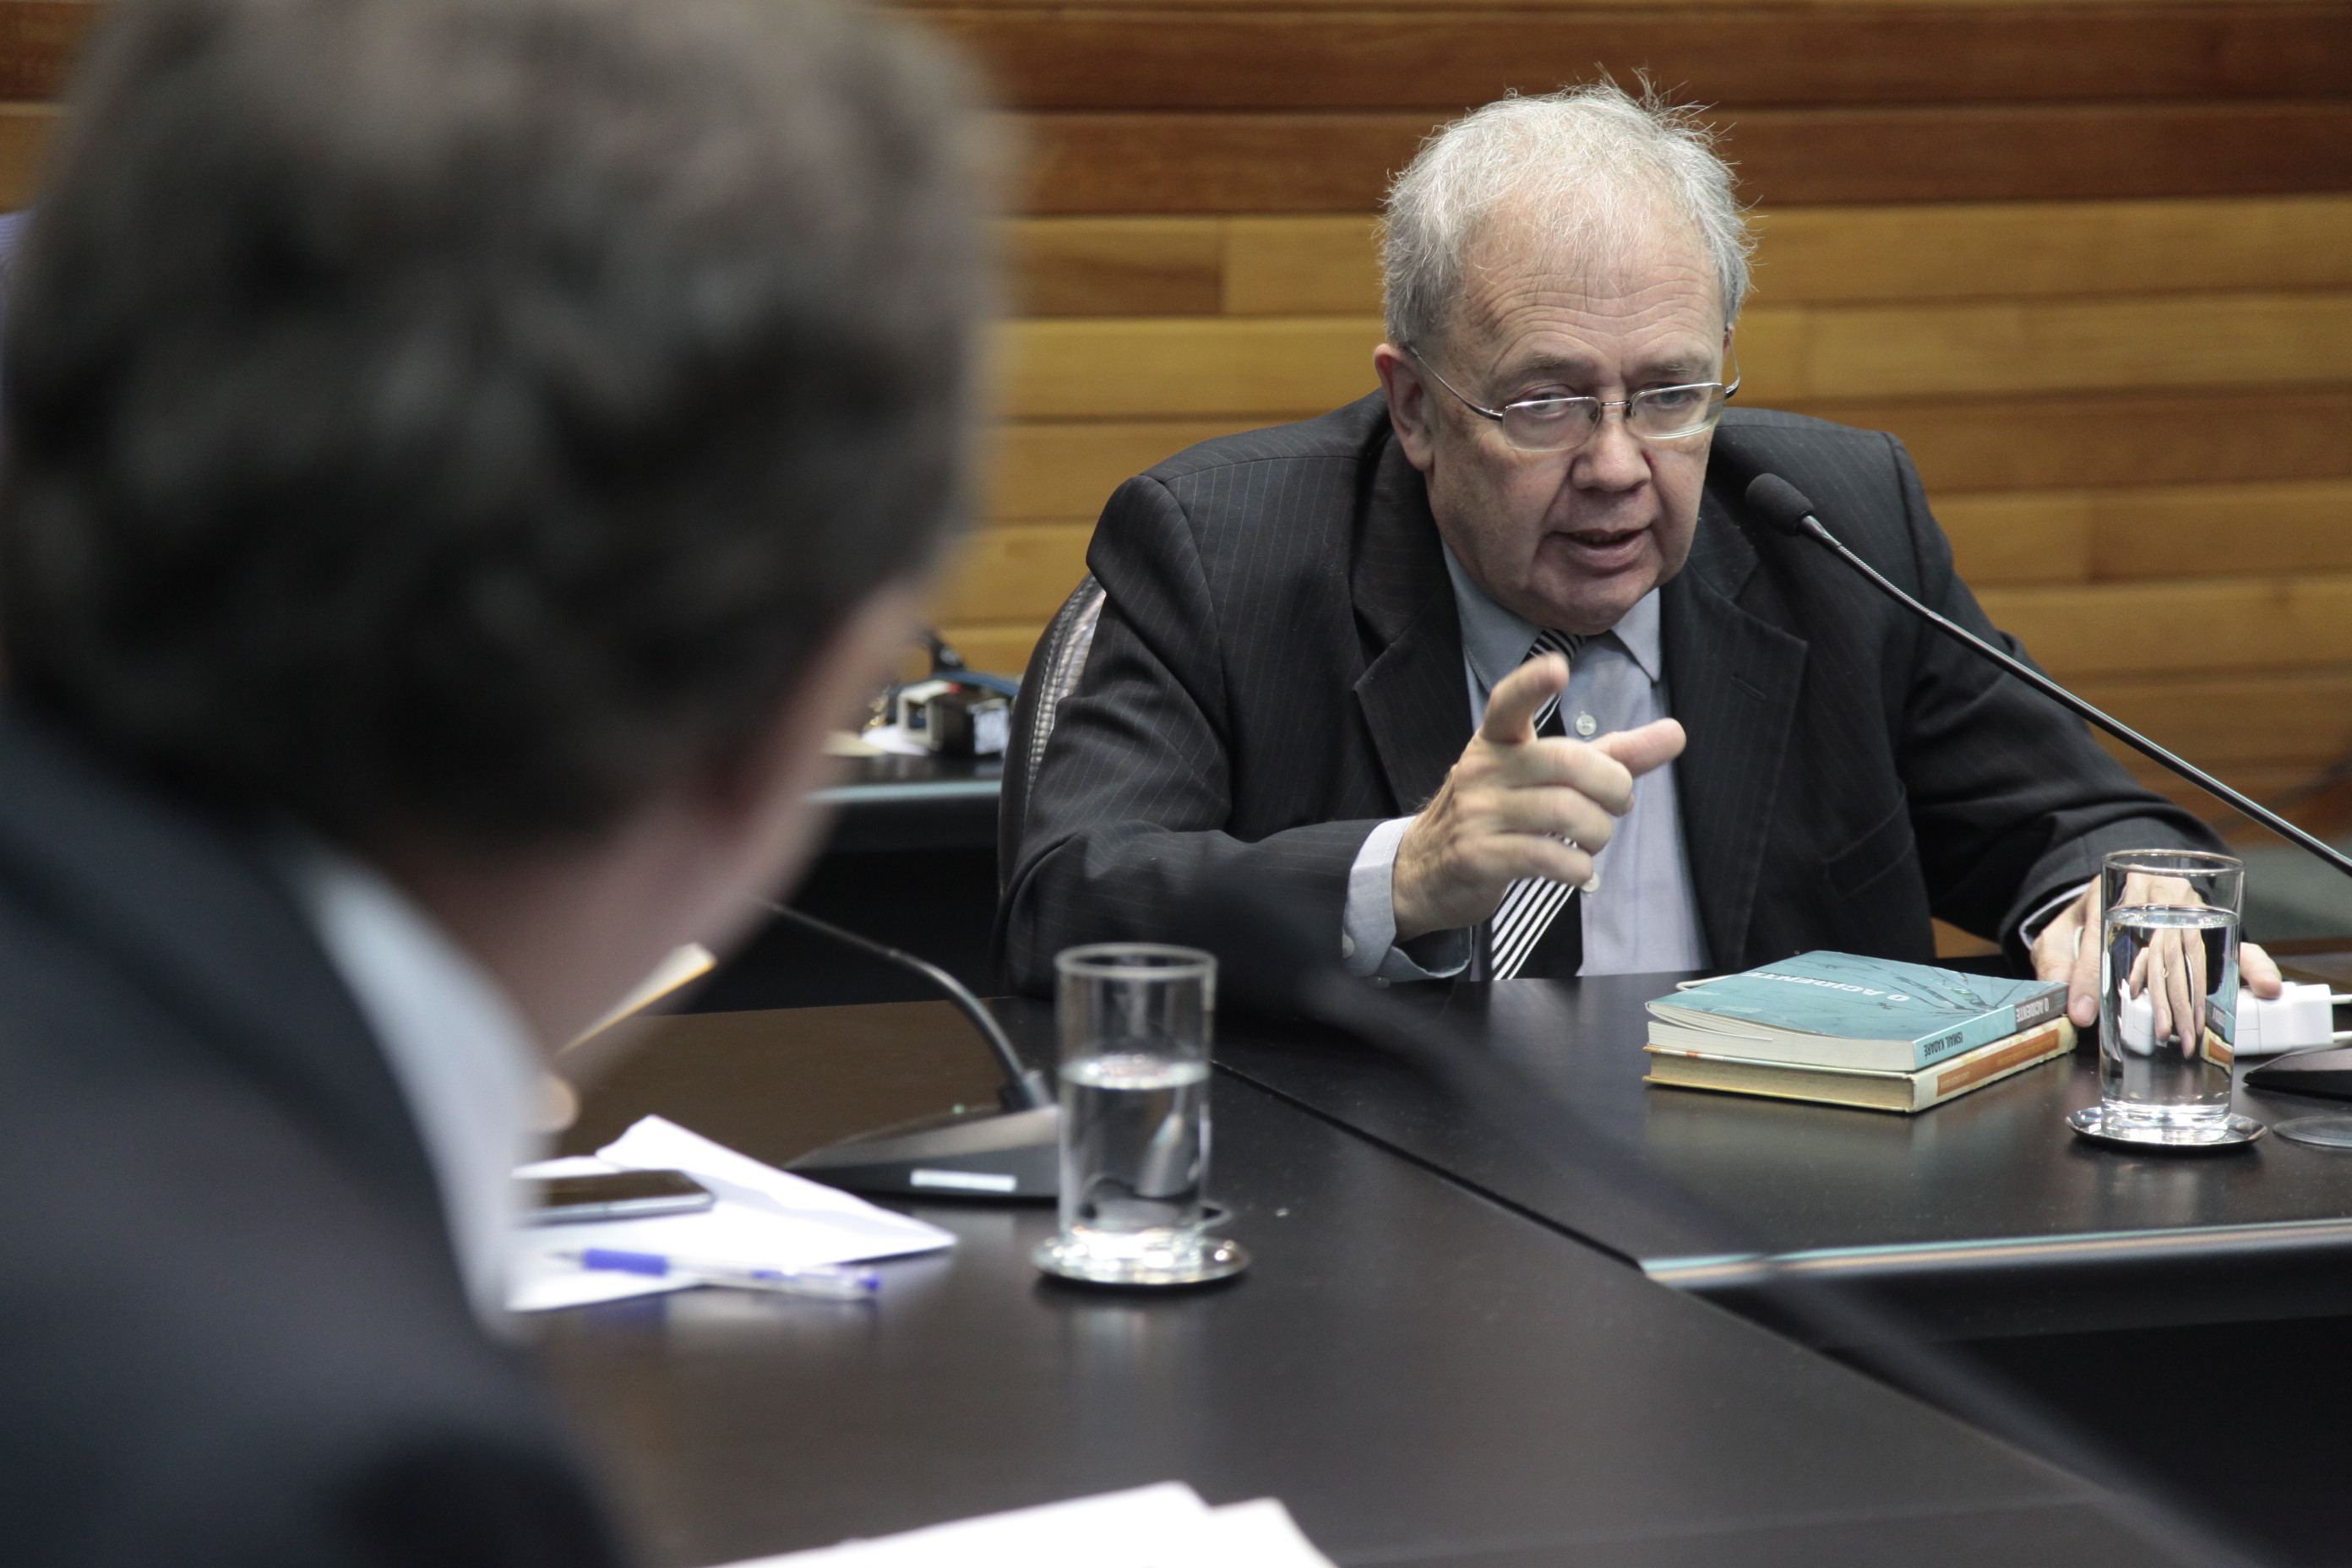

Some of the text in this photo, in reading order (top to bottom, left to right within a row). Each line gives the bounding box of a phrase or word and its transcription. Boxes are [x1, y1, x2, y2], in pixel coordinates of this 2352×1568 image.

[1741, 972, 1886, 996] ACIDENTE
[2016, 1000, 2044, 1022] ACIDENTE
[2044, 998, 2050, 1011] O
[1925, 1031, 1963, 1059] ISMAIL KADARÉ
